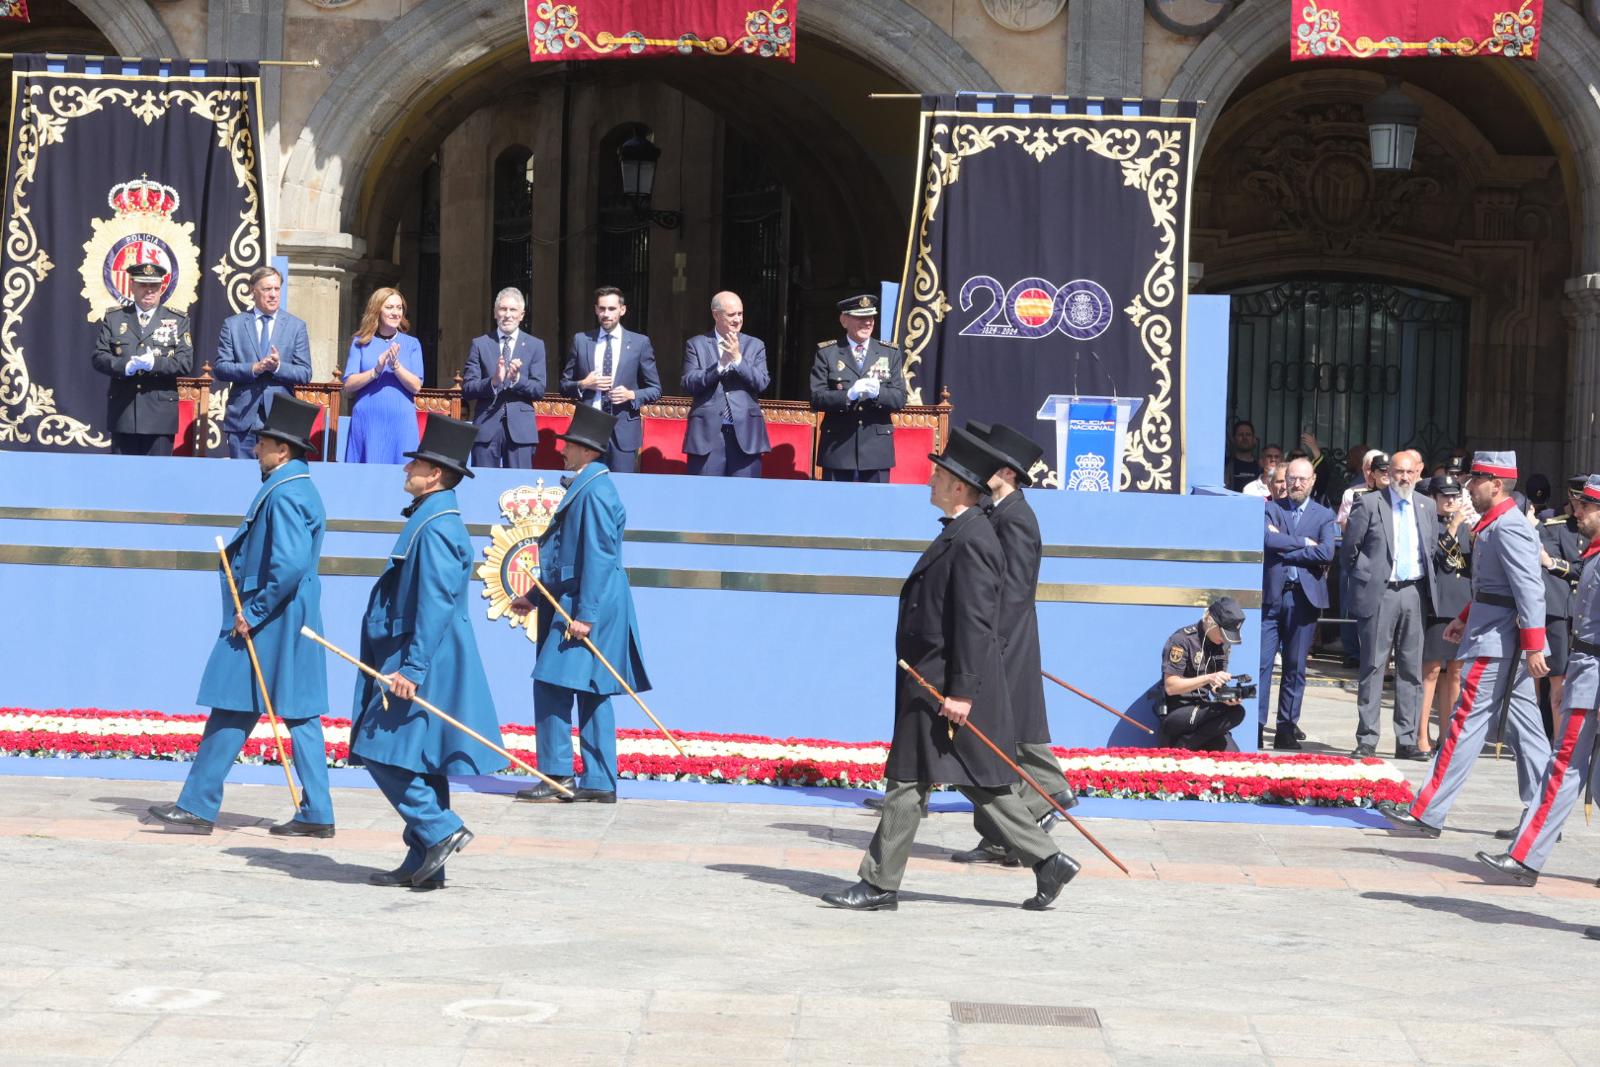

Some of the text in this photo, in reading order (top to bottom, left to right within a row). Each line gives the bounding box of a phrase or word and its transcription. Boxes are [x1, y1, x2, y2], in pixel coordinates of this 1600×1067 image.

[126, 234, 159, 245] POLICIA
[959, 275, 1113, 340] 200
[1001, 327, 1018, 336] 2024
[518, 538, 538, 548] POL
